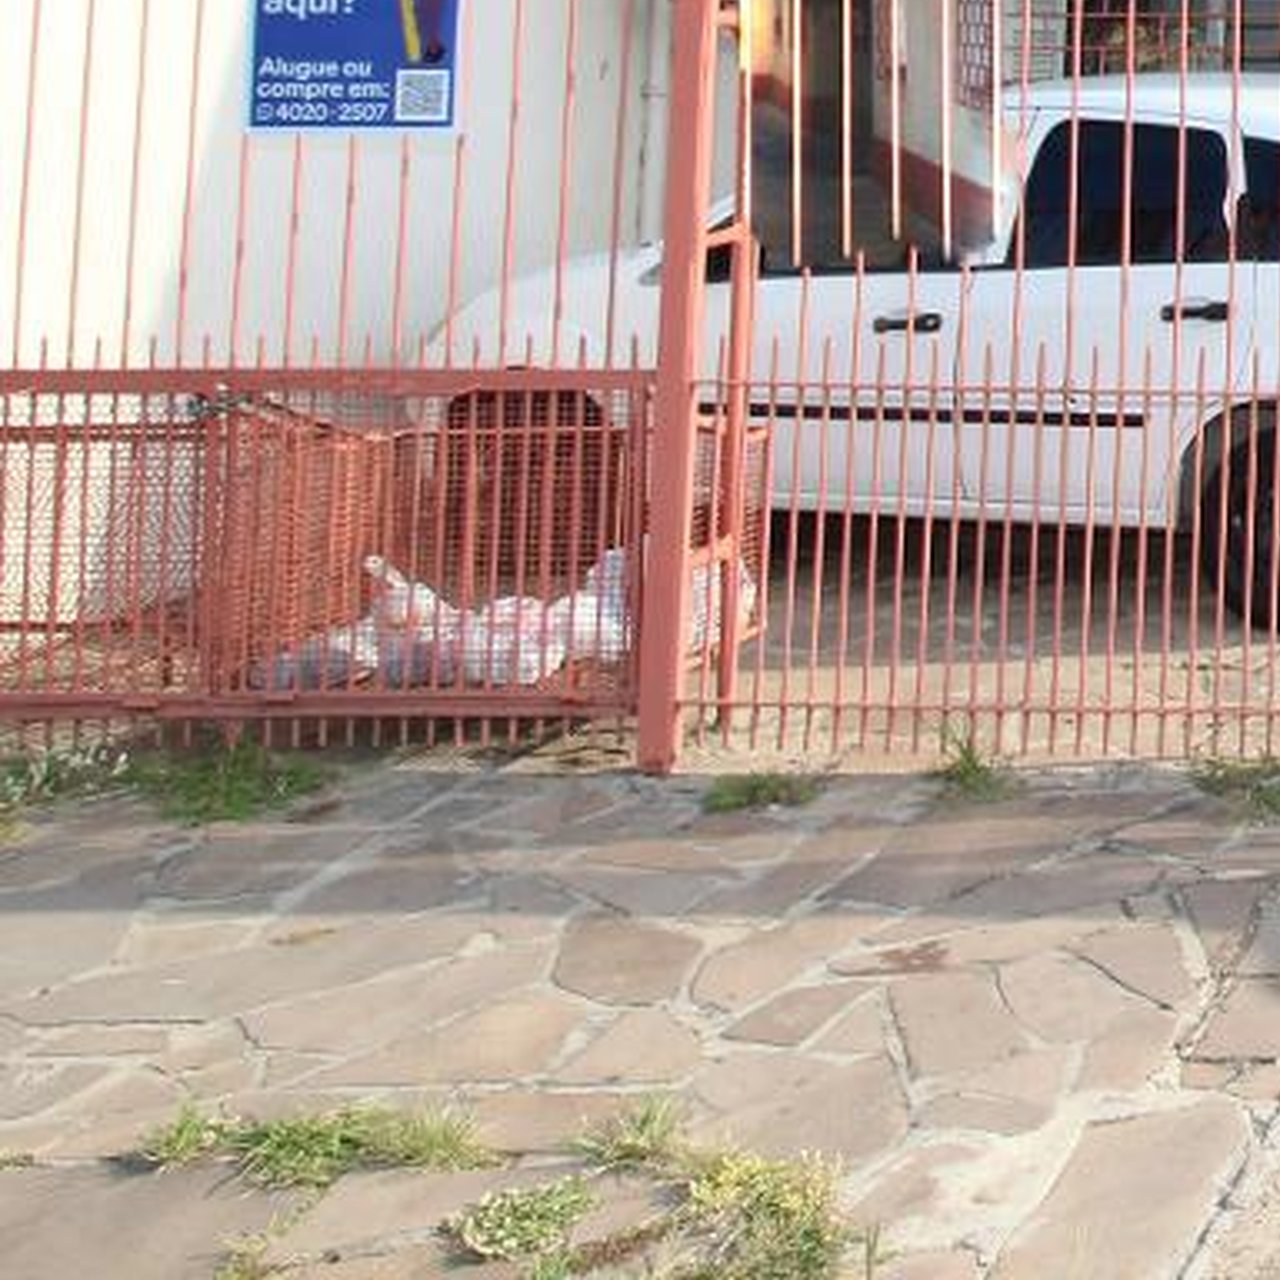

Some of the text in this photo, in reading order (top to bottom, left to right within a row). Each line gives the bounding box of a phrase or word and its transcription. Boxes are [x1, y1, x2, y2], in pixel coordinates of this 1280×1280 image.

[259, 57, 372, 80] Alugue ou
[256, 83, 390, 100] compre em:
